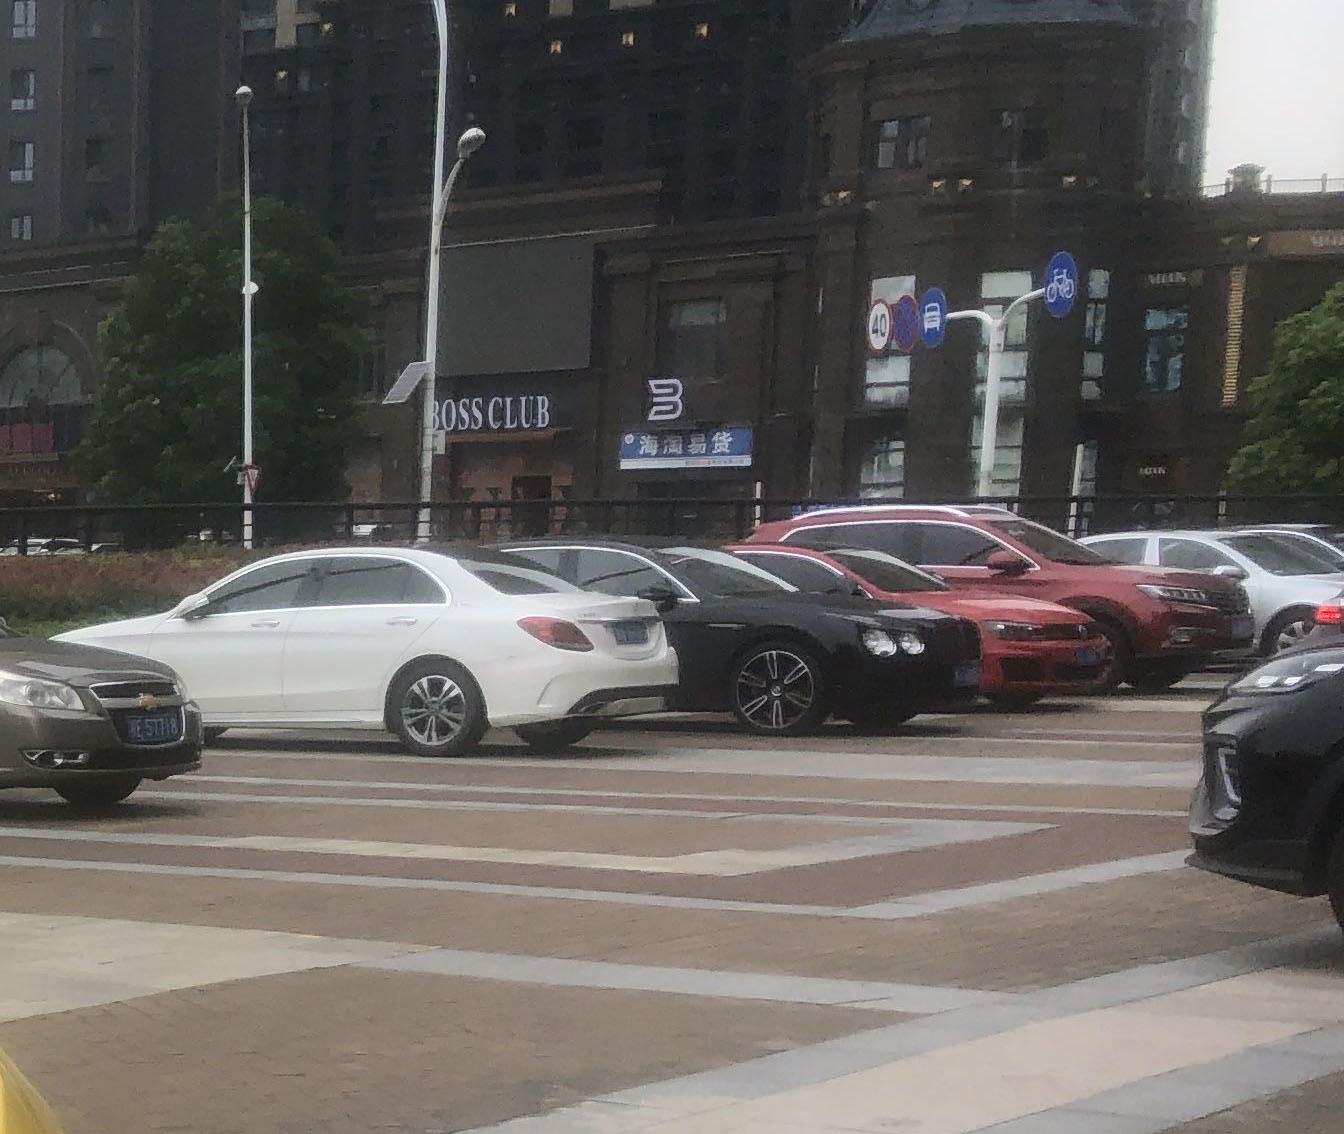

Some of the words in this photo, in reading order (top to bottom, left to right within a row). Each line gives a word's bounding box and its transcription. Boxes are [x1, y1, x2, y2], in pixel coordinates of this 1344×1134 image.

[871, 313, 887, 338] 40
[431, 397, 483, 431] BOSS
[488, 395, 550, 429] CLUB
